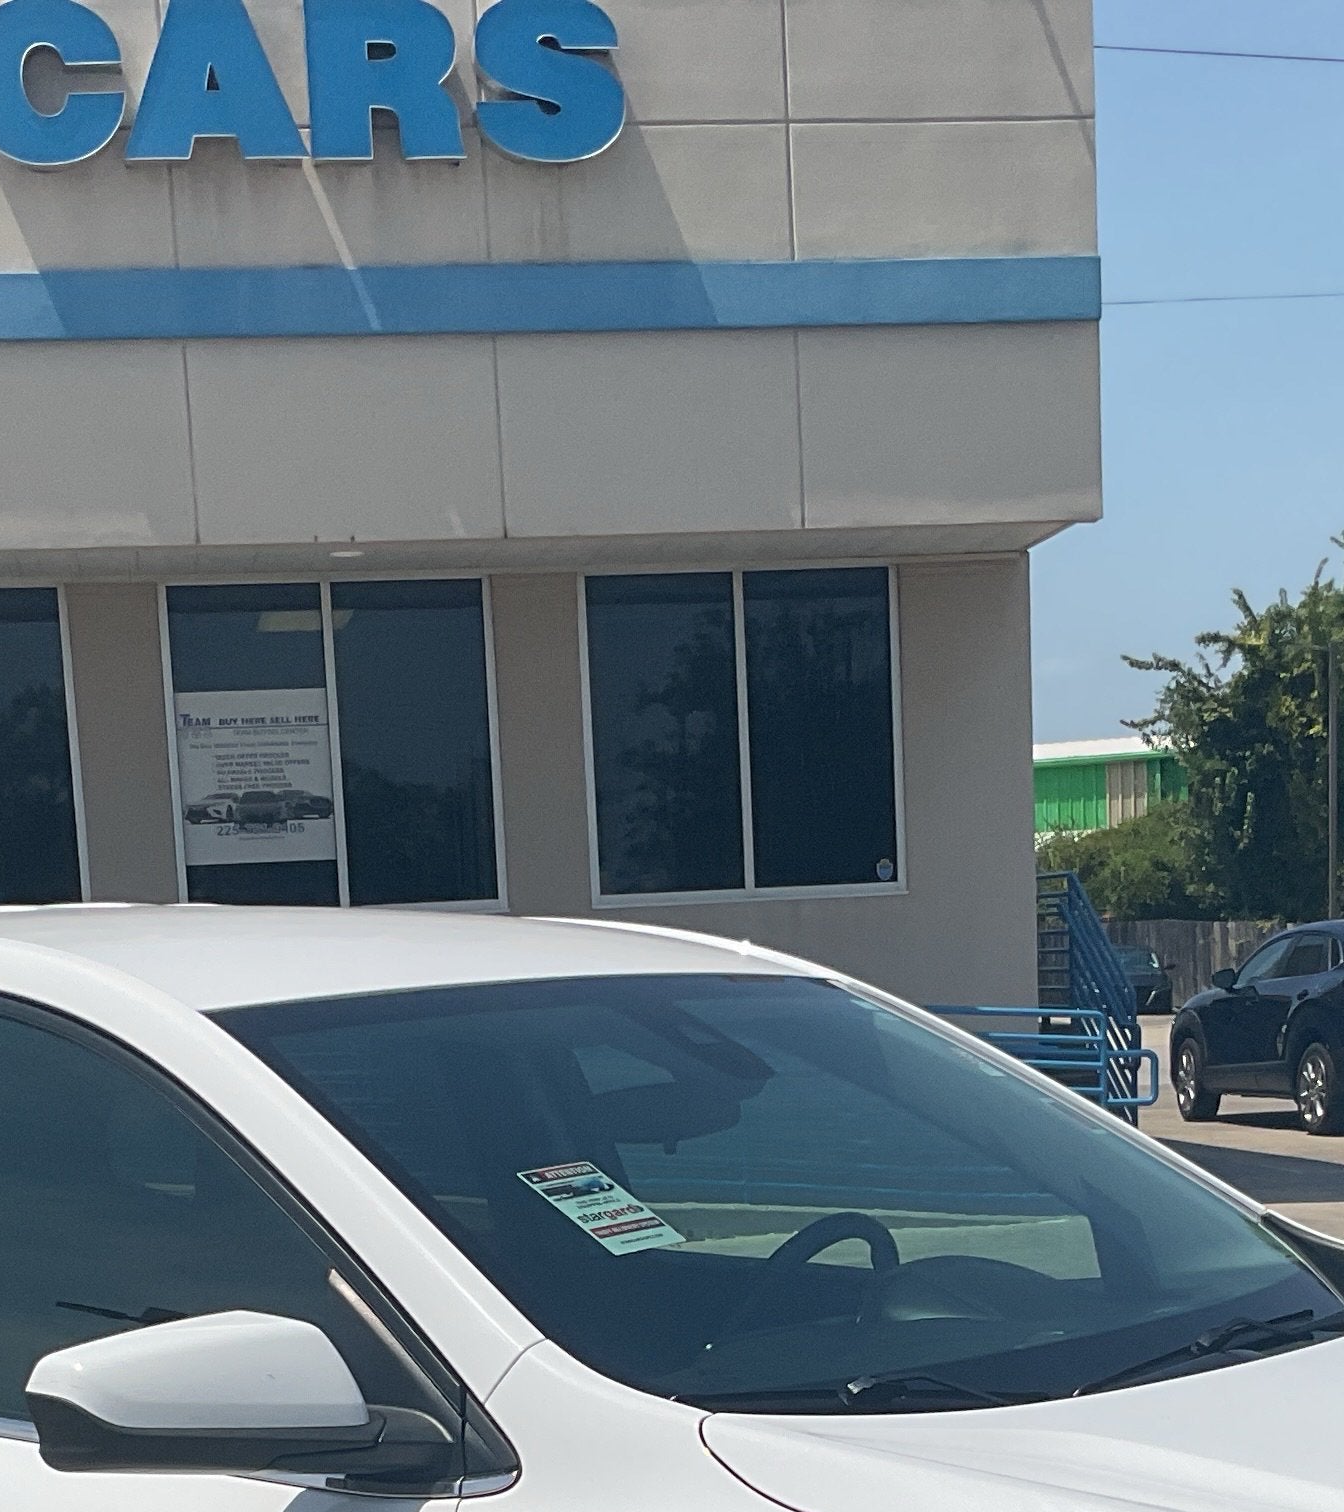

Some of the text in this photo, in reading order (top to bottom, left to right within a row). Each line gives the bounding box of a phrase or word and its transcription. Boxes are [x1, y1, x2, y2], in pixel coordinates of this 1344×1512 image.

[180, 714, 211, 727] TEAM
[218, 717, 239, 726] BUY
[241, 717, 267, 725] HERE
[269, 716, 292, 725] SELL
[543, 1165, 593, 1179] ATTENTION
[577, 1203, 642, 1224] stargard
